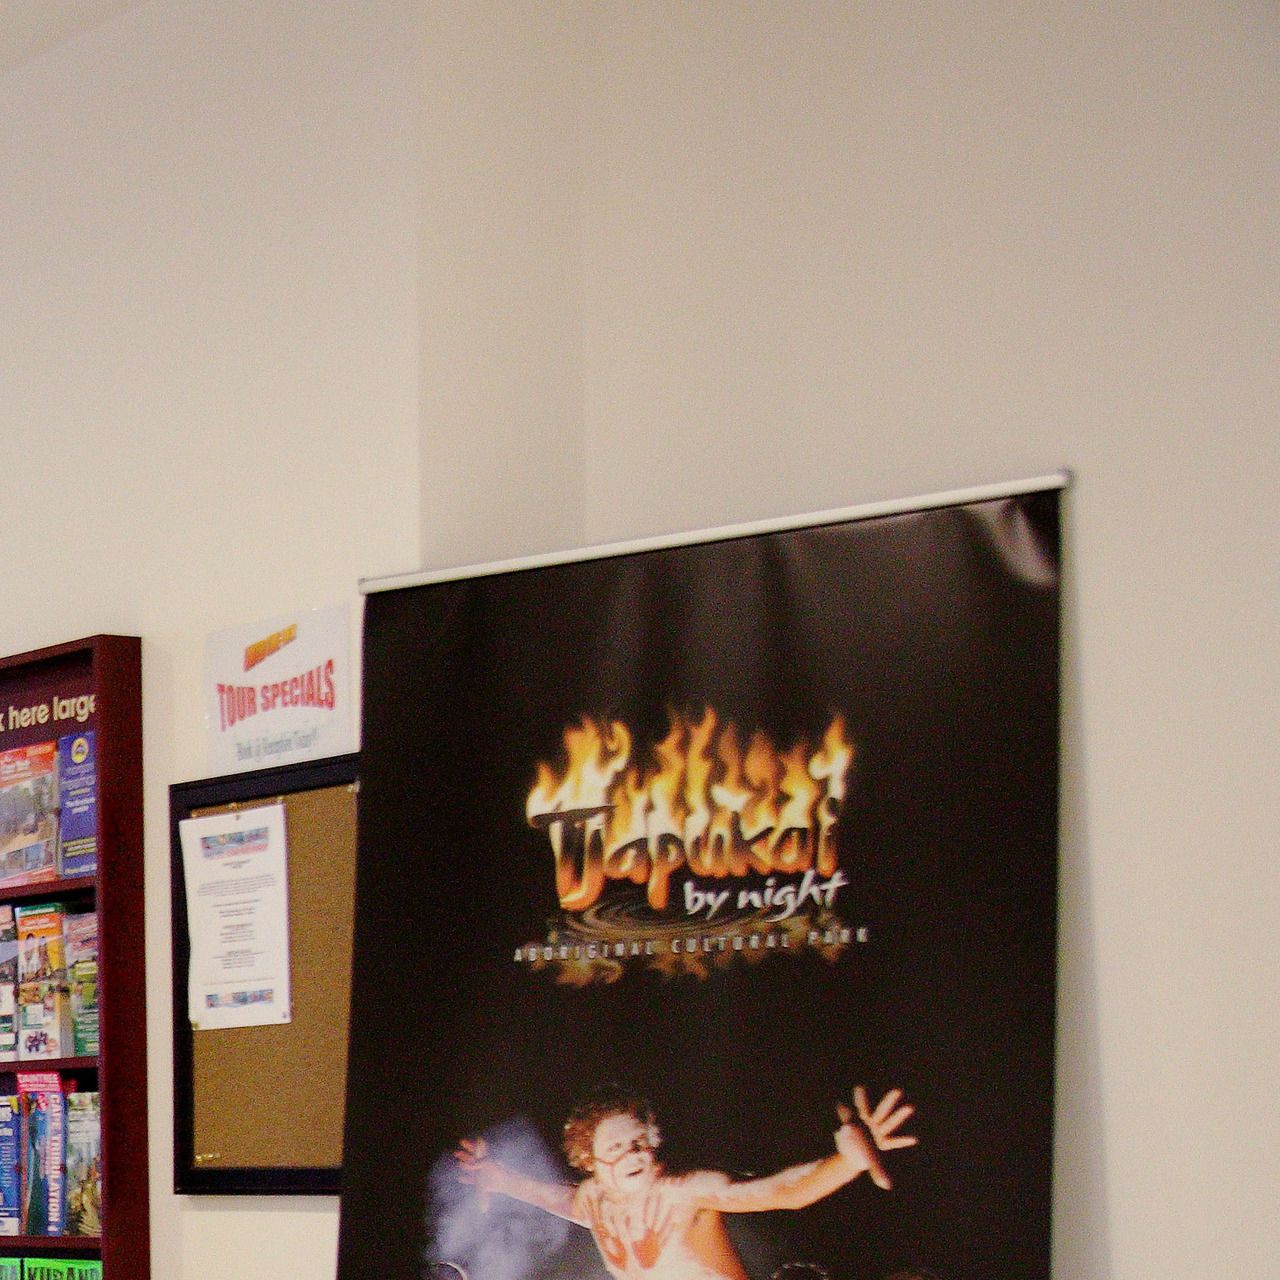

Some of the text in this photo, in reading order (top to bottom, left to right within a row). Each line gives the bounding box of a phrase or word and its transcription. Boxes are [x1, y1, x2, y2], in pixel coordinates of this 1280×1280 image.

[7, 702, 50, 731] here
[216, 658, 336, 733] TOUR SPECIALS
[683, 869, 849, 923] by night
[513, 927, 869, 963] ABORIGINAL CULTURAL PARK
